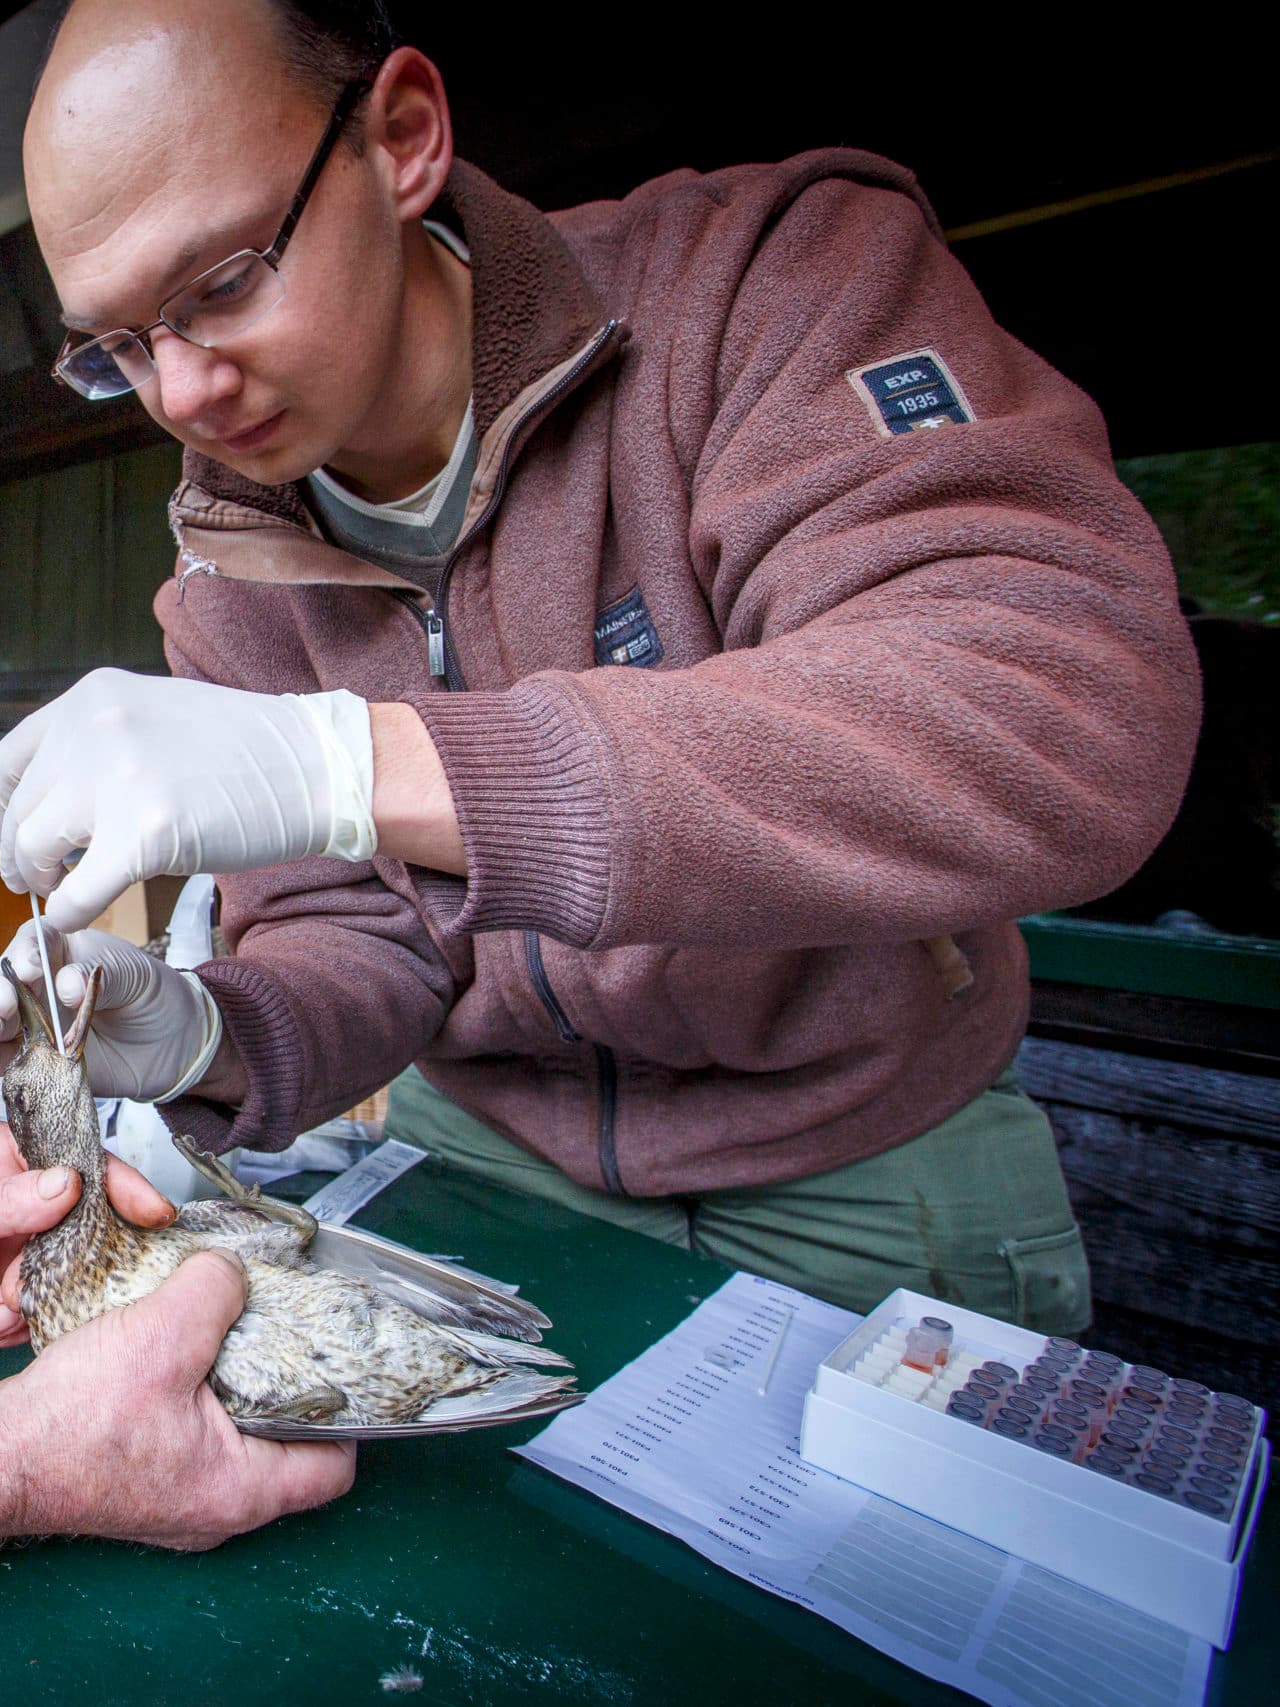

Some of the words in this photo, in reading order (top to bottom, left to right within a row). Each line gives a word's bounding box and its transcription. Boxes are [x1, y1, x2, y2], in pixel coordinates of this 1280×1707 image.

[884, 369, 929, 390] EXP.
[897, 391, 940, 416] 1935
[602, 1442, 640, 1463] P301-570
[591, 1455, 629, 1477] P301-569
[740, 1496, 782, 1519] C301-571
[749, 1485, 791, 1509] C301-572
[729, 1506, 771, 1529] C301-570
[719, 1518, 762, 1541] C301-569
[748, 1573, 815, 1606] www.avery.eu
